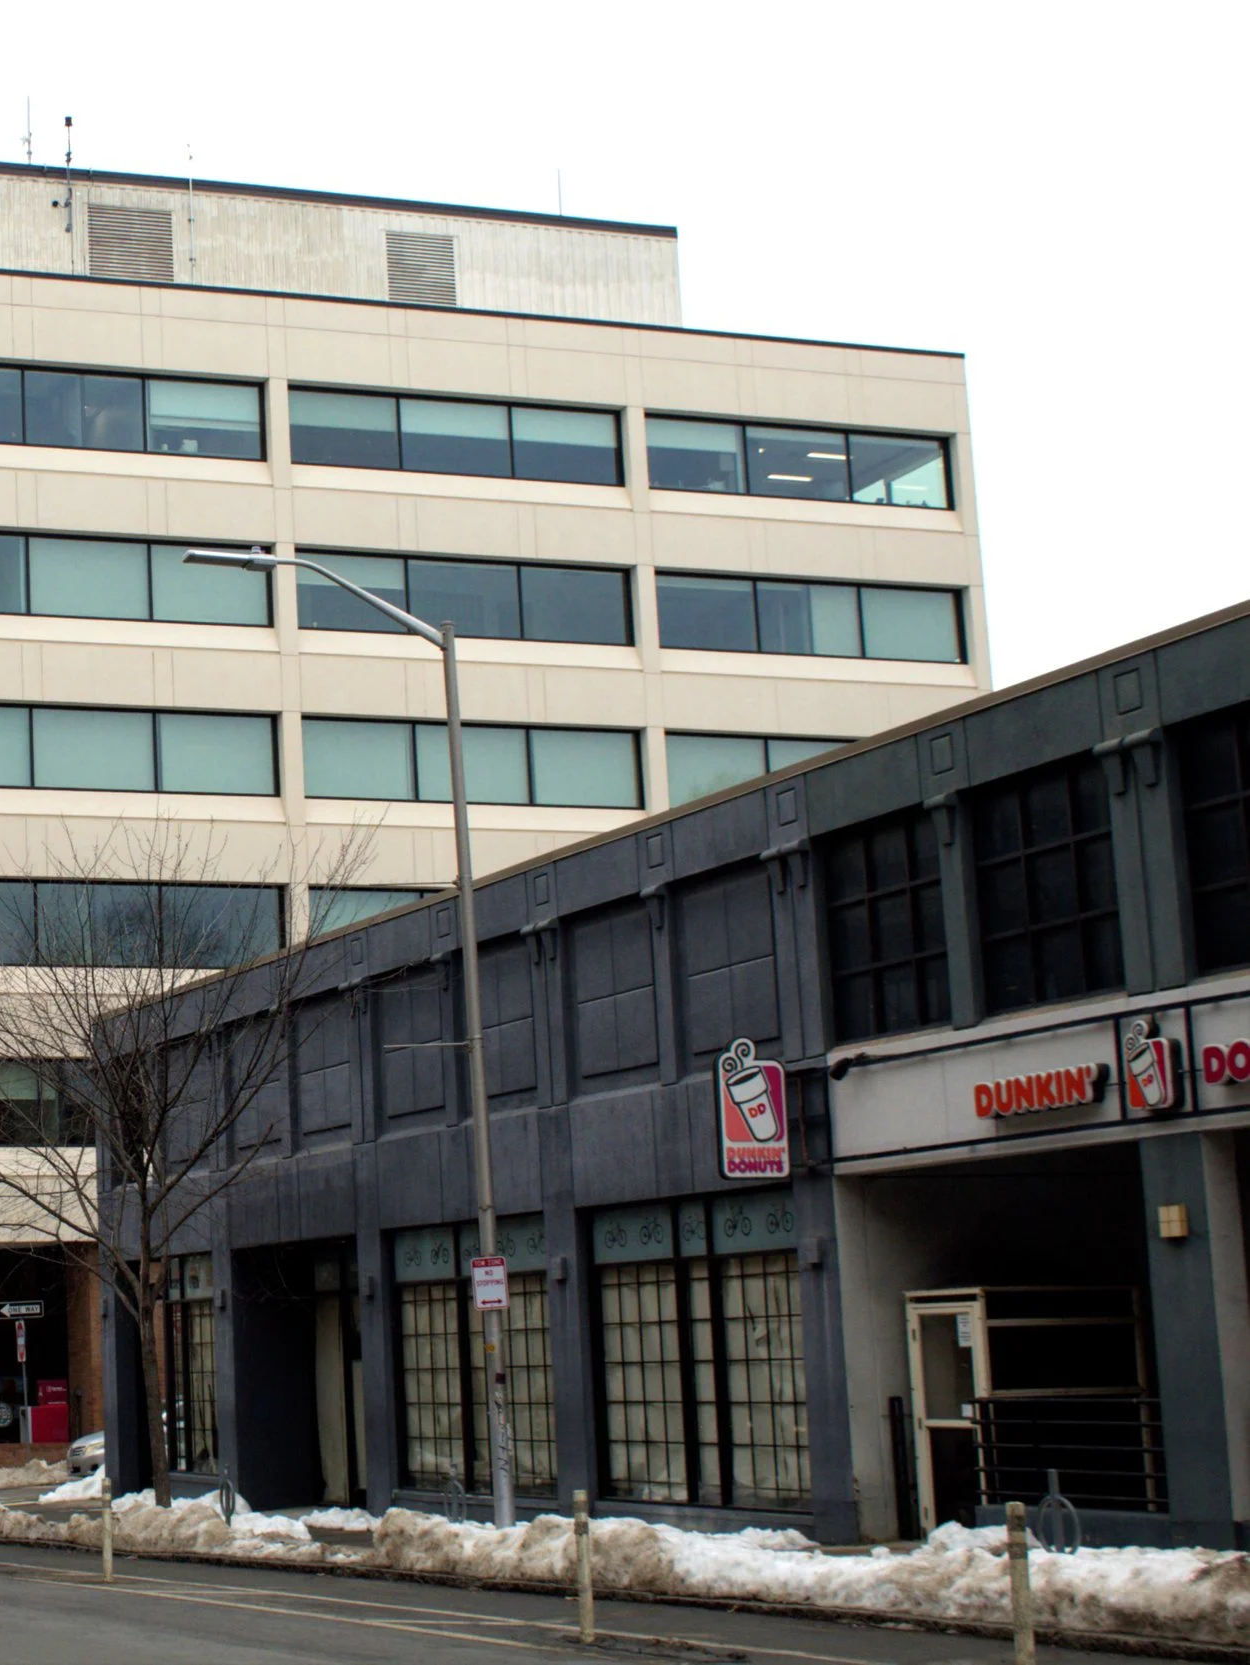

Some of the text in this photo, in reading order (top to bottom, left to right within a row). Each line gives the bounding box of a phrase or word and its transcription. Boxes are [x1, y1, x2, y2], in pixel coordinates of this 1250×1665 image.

[1203, 1041, 1250, 1084] DO
[974, 1065, 1092, 1118] DUNKIN'
[748, 1103, 766, 1118] DD
[727, 1160, 784, 1173] DONUTS
[476, 1278, 504, 1287] STOPPING
